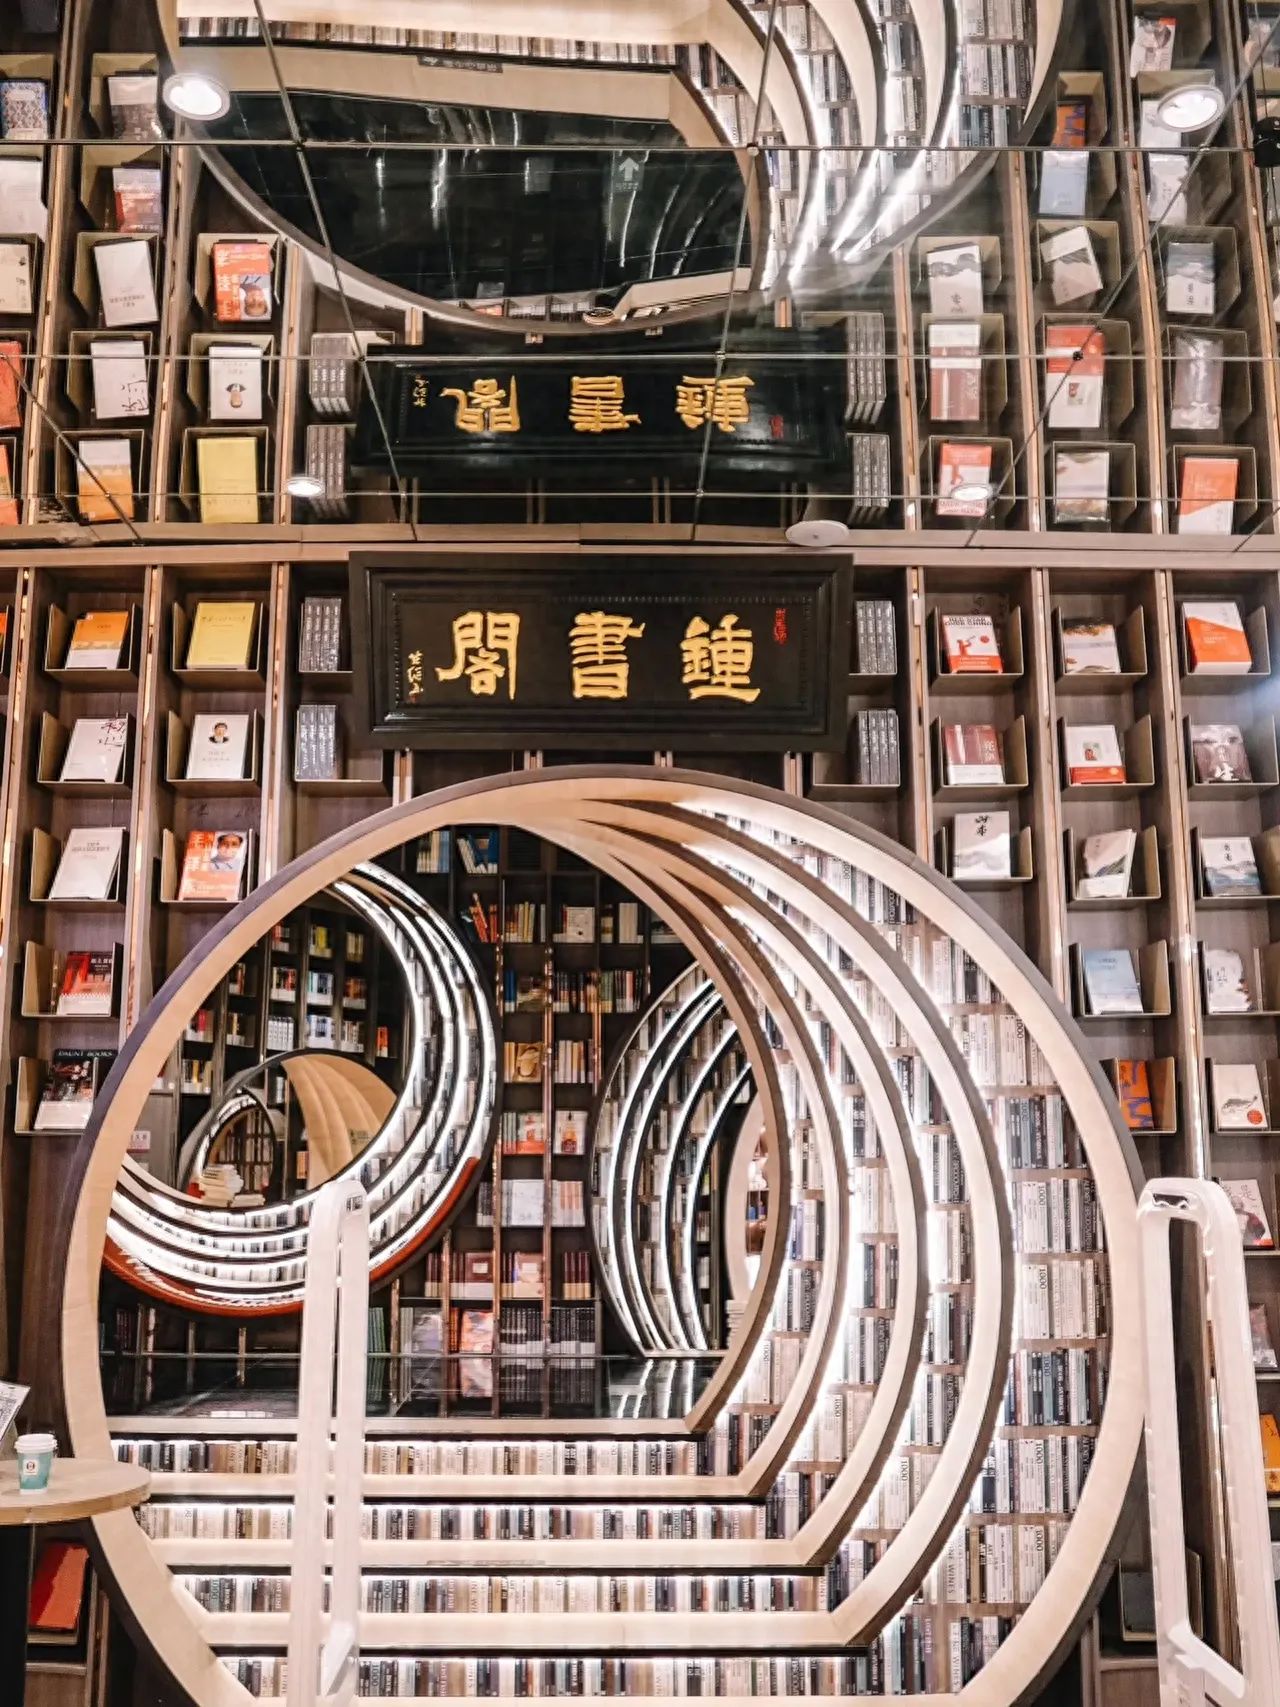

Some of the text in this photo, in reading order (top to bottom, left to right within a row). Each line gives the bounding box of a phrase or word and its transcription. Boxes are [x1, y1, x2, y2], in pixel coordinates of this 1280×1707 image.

[1016, 1018, 1024, 1039] 1000
[1038, 1185, 1047, 1206] 1000
[1039, 1268, 1047, 1290] 1000
[1035, 1442, 1043, 1464] 1000
[1036, 1530, 1044, 1552] 1000
